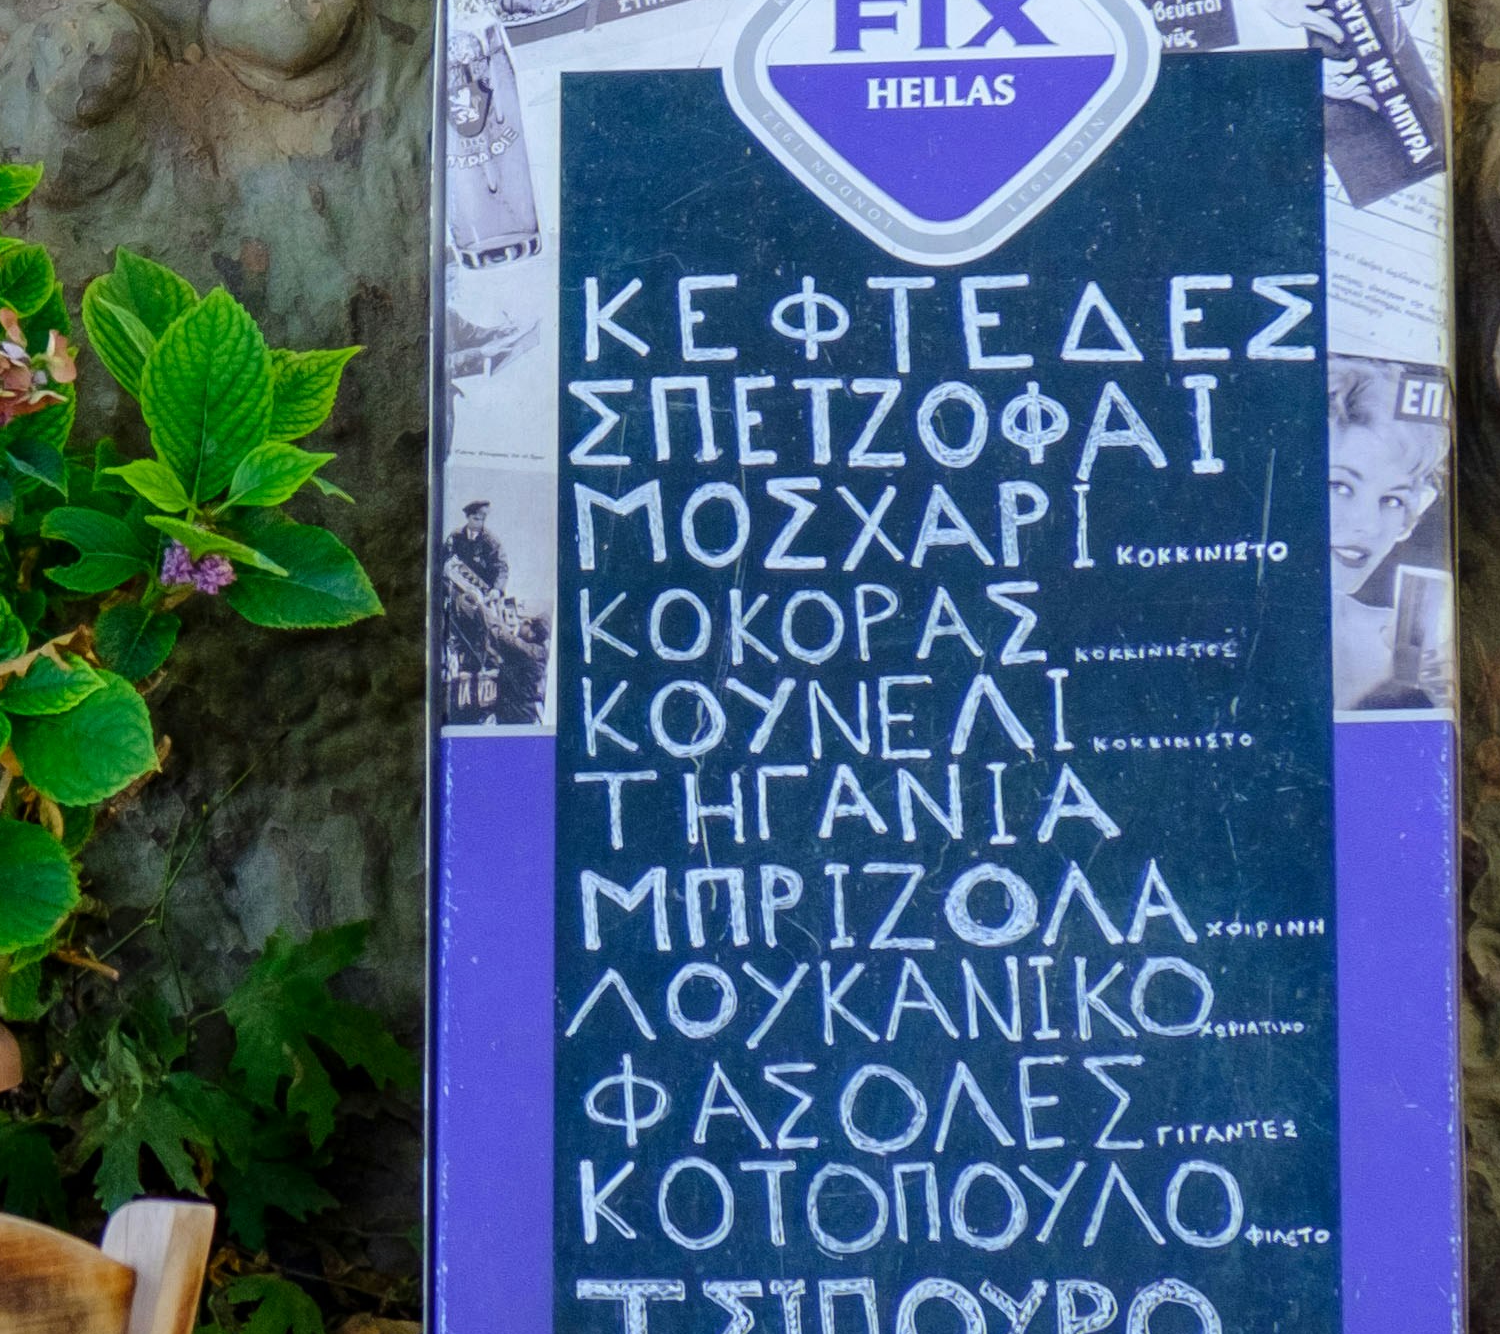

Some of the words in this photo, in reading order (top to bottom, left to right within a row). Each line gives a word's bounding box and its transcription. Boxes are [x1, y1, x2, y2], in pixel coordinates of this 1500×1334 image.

[866, 73, 1017, 110] HELLAS
[1366, 56, 1398, 94] ΜΕ
[584, 273, 1321, 372] ΚΕΦΤΕΔΕΣ
[568, 374, 1226, 480] ΣΠΕΤΖΟΦΑΙ
[573, 477, 1095, 571] ΜΟΣΧΑΡΙ
[1116, 541, 1288, 568] ΚΟΚΚΙΝΙΣΤΟ
[579, 580, 1048, 666] ΚΟΚΟΡΑΣ
[1074, 640, 1238, 663] ΚΟΚΚΙΝΙΣΤΟΣ
[581, 668, 1075, 759] ΚΟΥΝΕΛΙ
[574, 762, 1122, 851] ΤΗΓΑΝΙΑ
[580, 859, 1198, 951] ΜΠΡΙΖΟΛΑ
[1206, 918, 1325, 939] ΧΟΙΡΙΝΗ
[565, 956, 1215, 1049] ΛΟΥΚΑΝΙΚΟ
[584, 1053, 1145, 1154] ΦΑΣΟΛΕΣ
[1156, 1119, 1298, 1147] ΓΙΓΑΝΤΕΣ
[579, 1156, 1244, 1255] ΚΟΤΟΠΟΥΛΟ
[1244, 1223, 1331, 1247] ΦΙΛΕΤΟ
